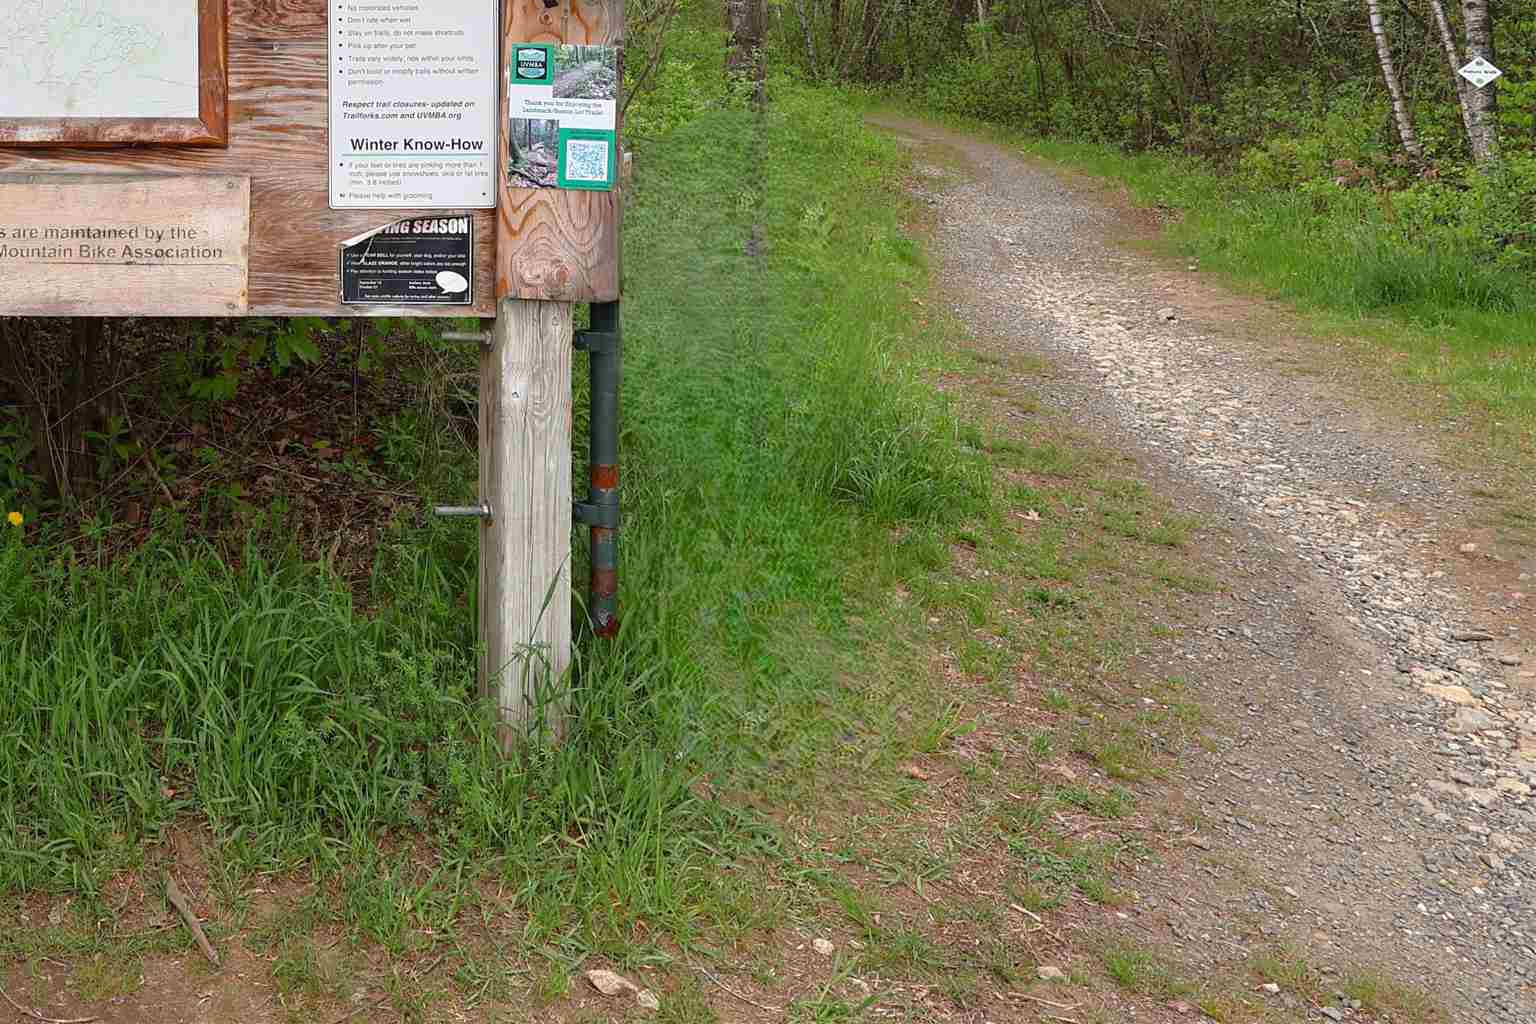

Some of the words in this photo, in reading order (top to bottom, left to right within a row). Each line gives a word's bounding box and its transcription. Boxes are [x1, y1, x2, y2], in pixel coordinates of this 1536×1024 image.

[342, 101, 375, 109] Respect
[376, 101, 391, 109] trail
[431, 101, 463, 109] updated
[464, 101, 475, 109] on
[400, 112, 414, 120] and
[350, 138, 398, 151] Winter
[404, 138, 484, 151] Know-How
[383, 219, 410, 234] ING
[412, 218, 469, 234] SEASON
[11, 228, 39, 239] are
[44, 224, 138, 239] maintained
[144, 224, 165, 243] by
[170, 224, 197, 239] the
[78, 244, 117, 258] Bike
[121, 244, 224, 259] Association
